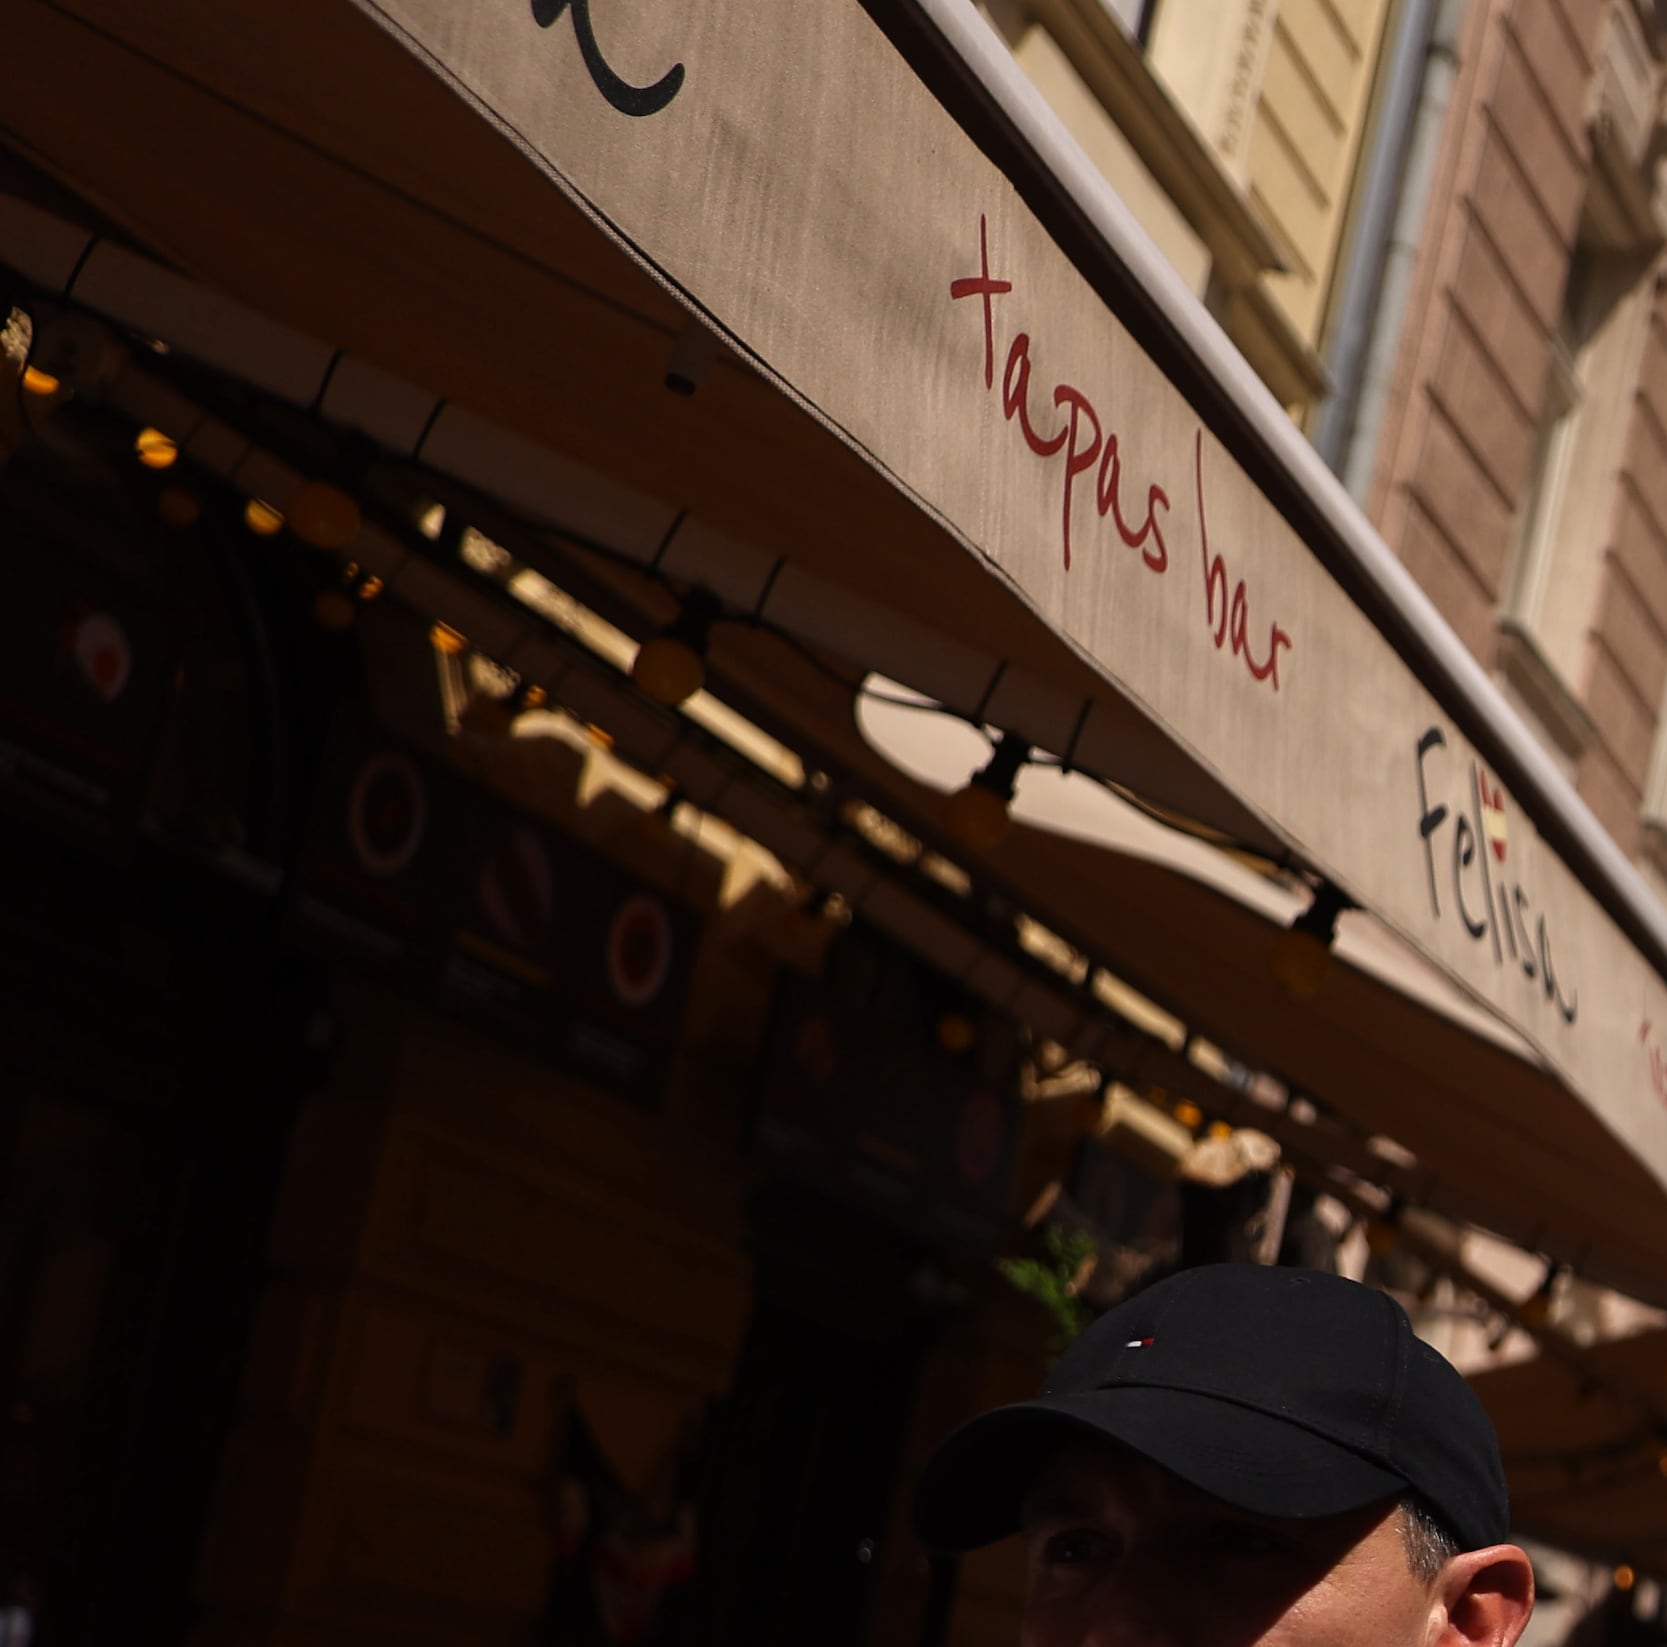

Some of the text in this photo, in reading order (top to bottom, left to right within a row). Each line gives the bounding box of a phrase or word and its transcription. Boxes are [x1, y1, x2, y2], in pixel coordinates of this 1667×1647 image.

[951, 213, 1292, 692] tapas bar
[1416, 725, 1579, 1024] Felisa
